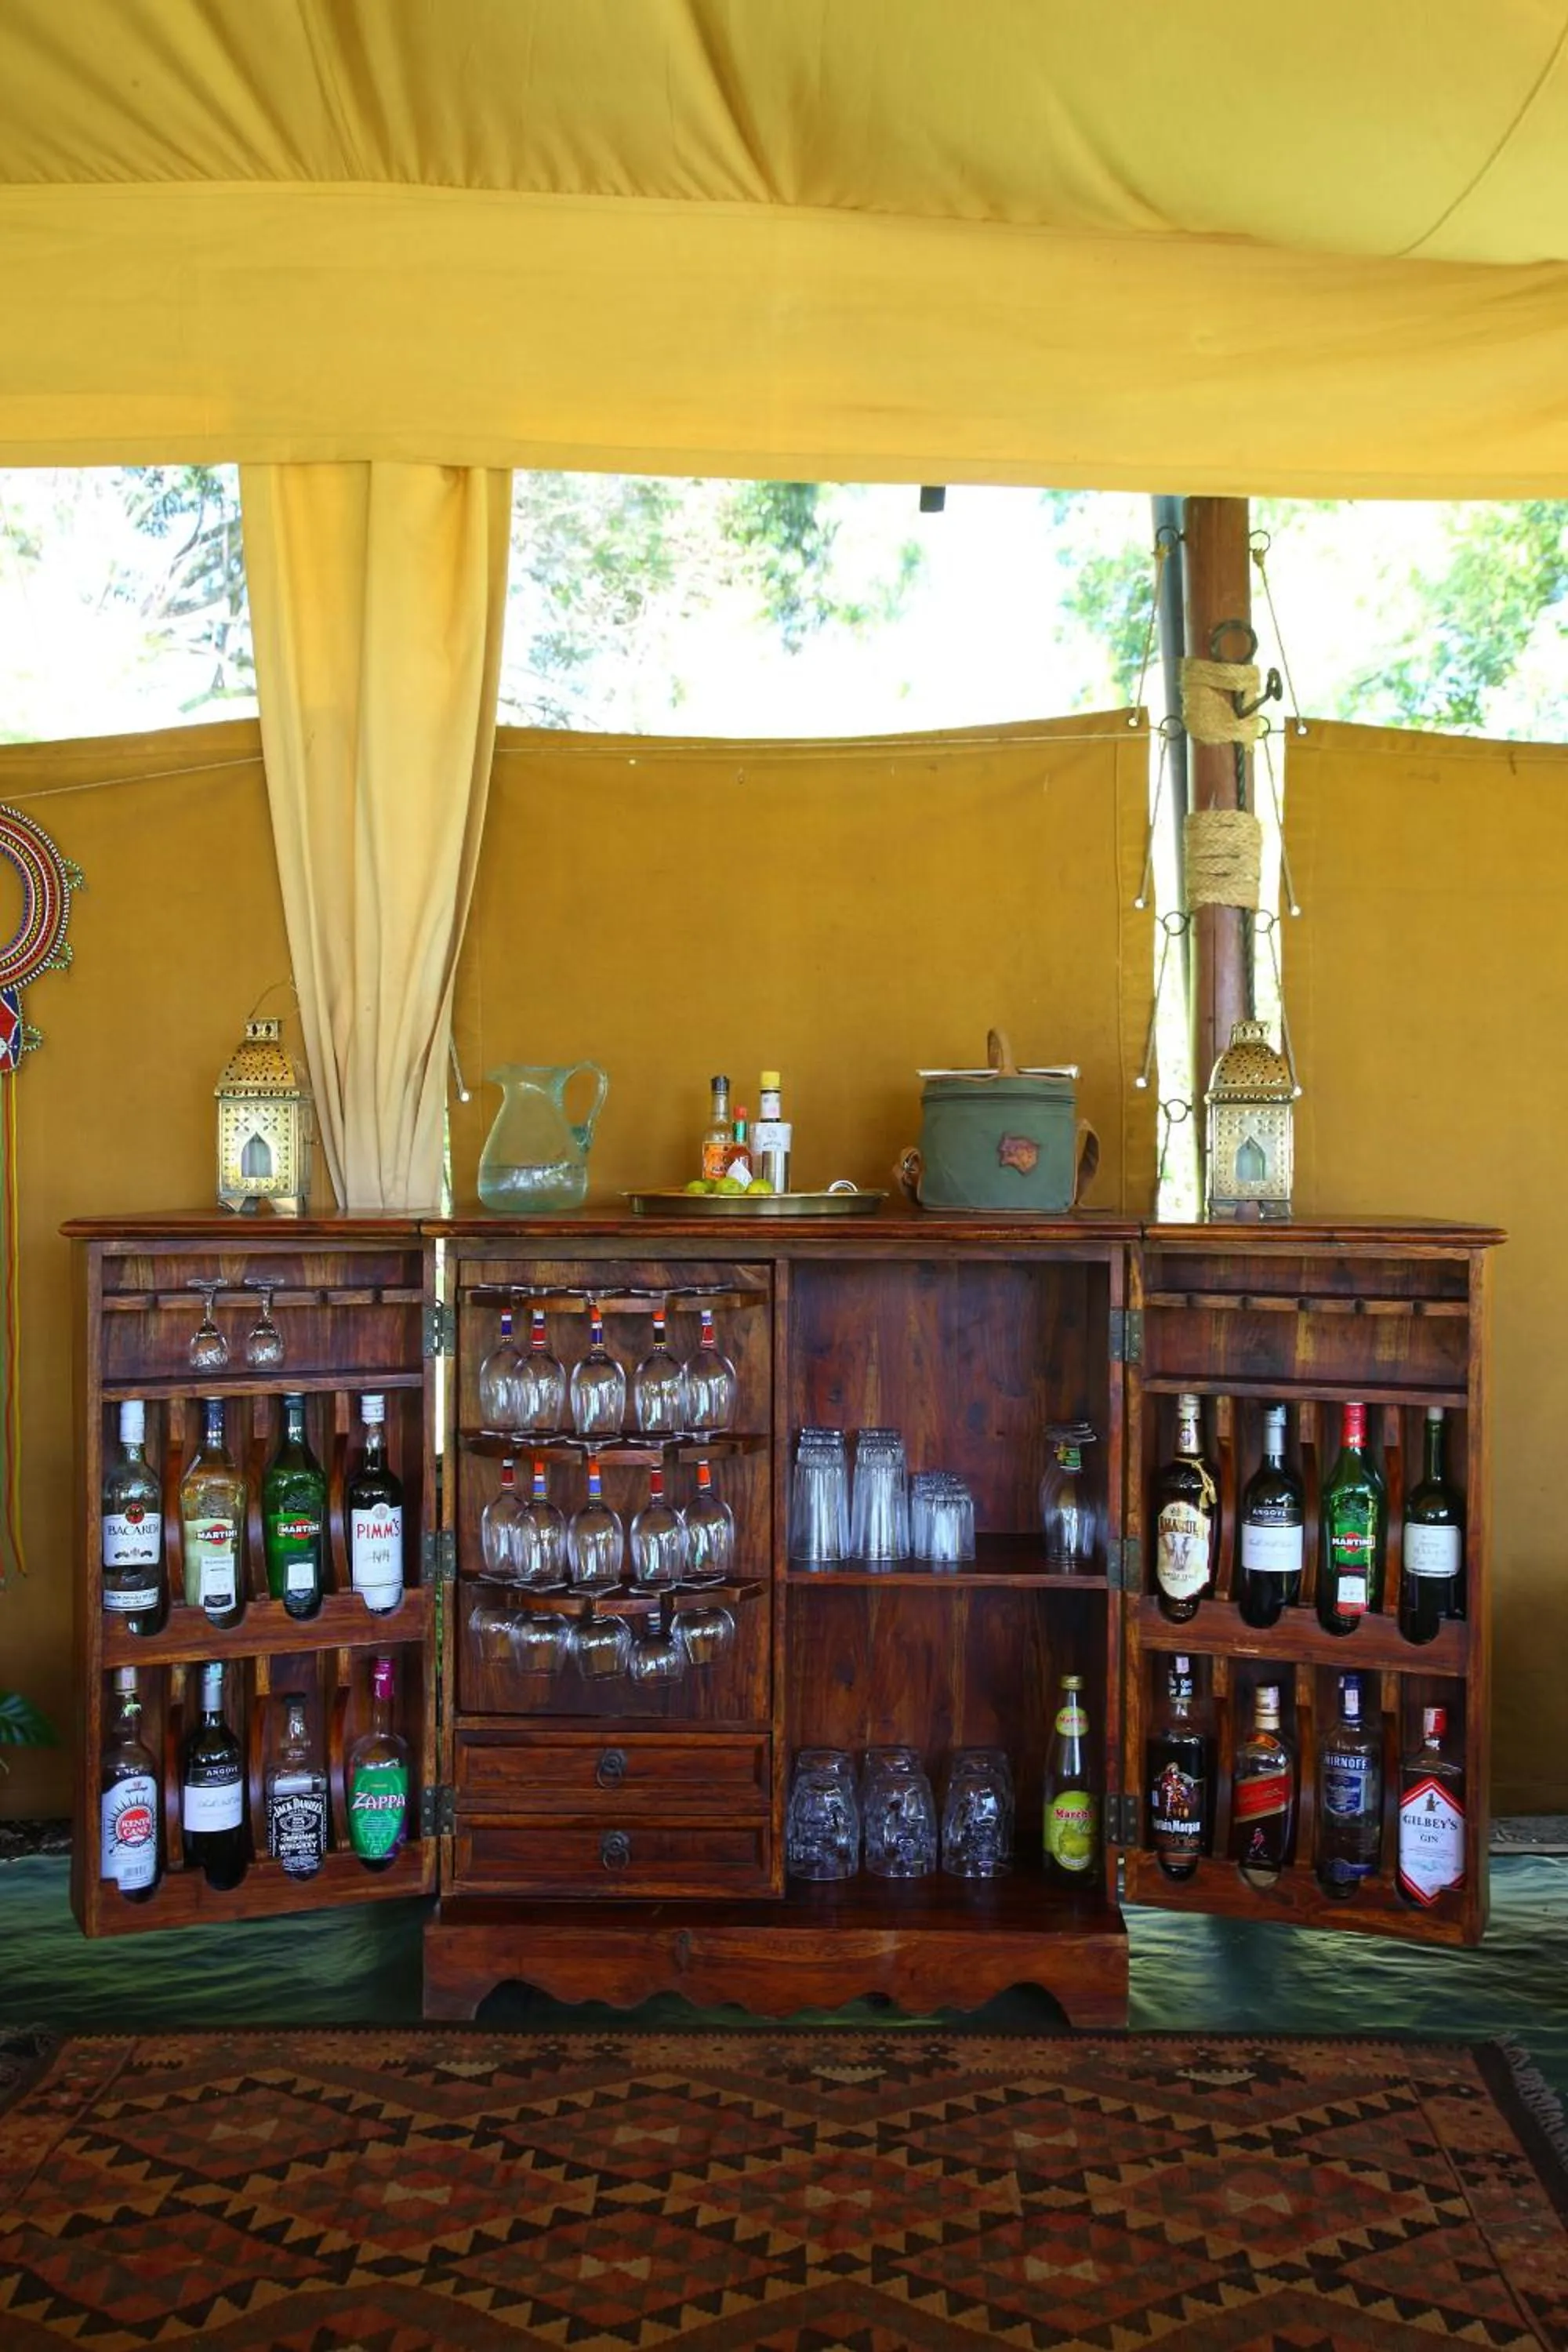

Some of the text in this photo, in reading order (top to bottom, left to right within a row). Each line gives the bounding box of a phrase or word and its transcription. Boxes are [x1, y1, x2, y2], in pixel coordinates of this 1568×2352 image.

[107, 1524, 158, 1536] BACARDI
[198, 1530, 237, 1539] MARTINI
[281, 1524, 319, 1533] MARTINI
[357, 1518, 401, 1539] PIMM'S
[1332, 1537, 1373, 1546] MARTINI
[351, 1792, 405, 1809] ZAPPA
[274, 1802, 292, 1817] JACK
[1403, 1815, 1459, 1831] GILBEY'S
[1420, 1834, 1439, 1843] GIN
